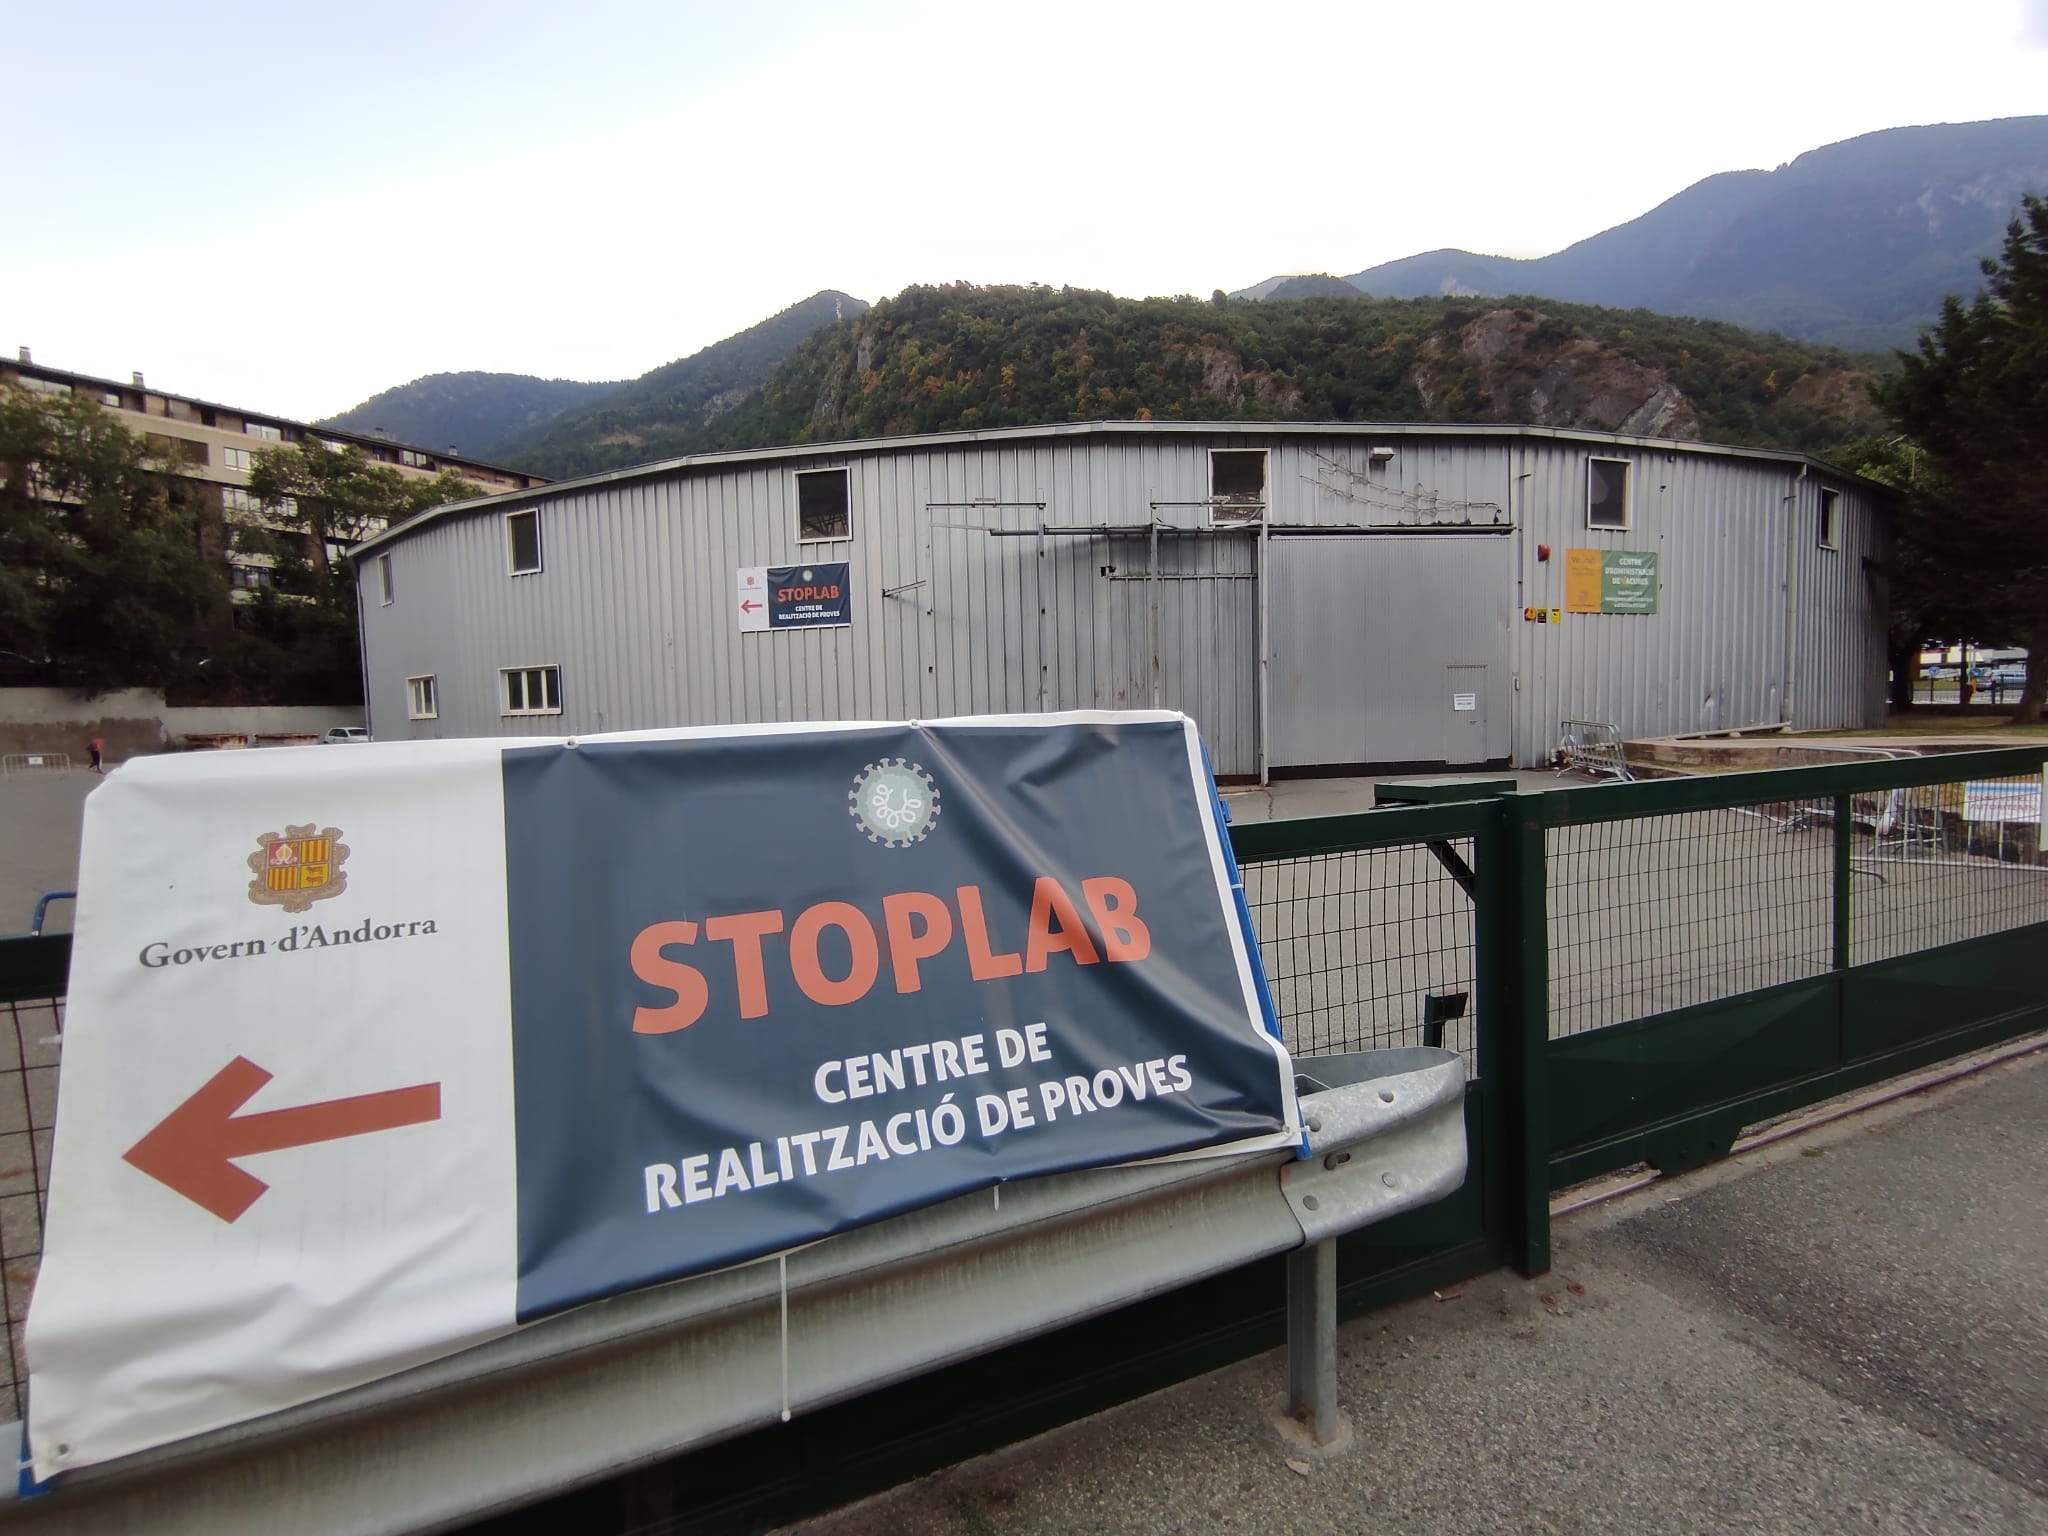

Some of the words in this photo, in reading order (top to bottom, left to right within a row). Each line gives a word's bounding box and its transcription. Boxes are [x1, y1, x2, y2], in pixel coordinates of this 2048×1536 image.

[778, 585, 840, 602] STOPLAB
[138, 939, 267, 968] Govern
[278, 918, 437, 952] d'Andorra
[629, 876, 1151, 1035] STOPLAB
[814, 1033, 989, 1104] CENTRE
[996, 1022, 1052, 1069] DE
[644, 1092, 966, 1214] REALITZACIÓ
[976, 1087, 1036, 1138] DE
[1041, 1054, 1193, 1123] PROVES
